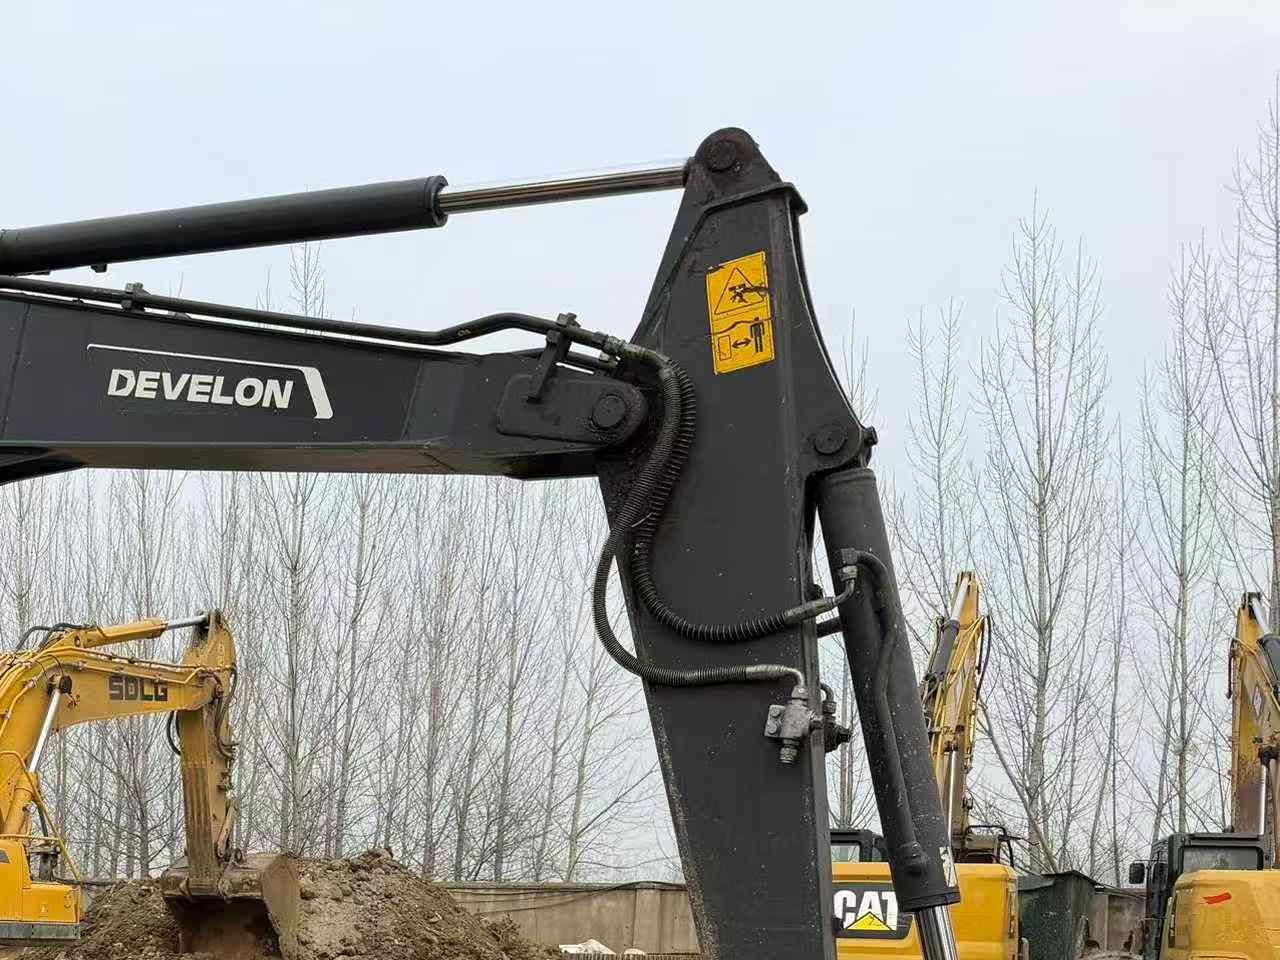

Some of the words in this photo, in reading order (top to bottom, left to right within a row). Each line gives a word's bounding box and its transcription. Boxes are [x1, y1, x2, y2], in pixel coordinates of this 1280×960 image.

[107, 368, 294, 409] DEVELON
[109, 675, 168, 702] SDLG
[833, 889, 899, 931] CAT
